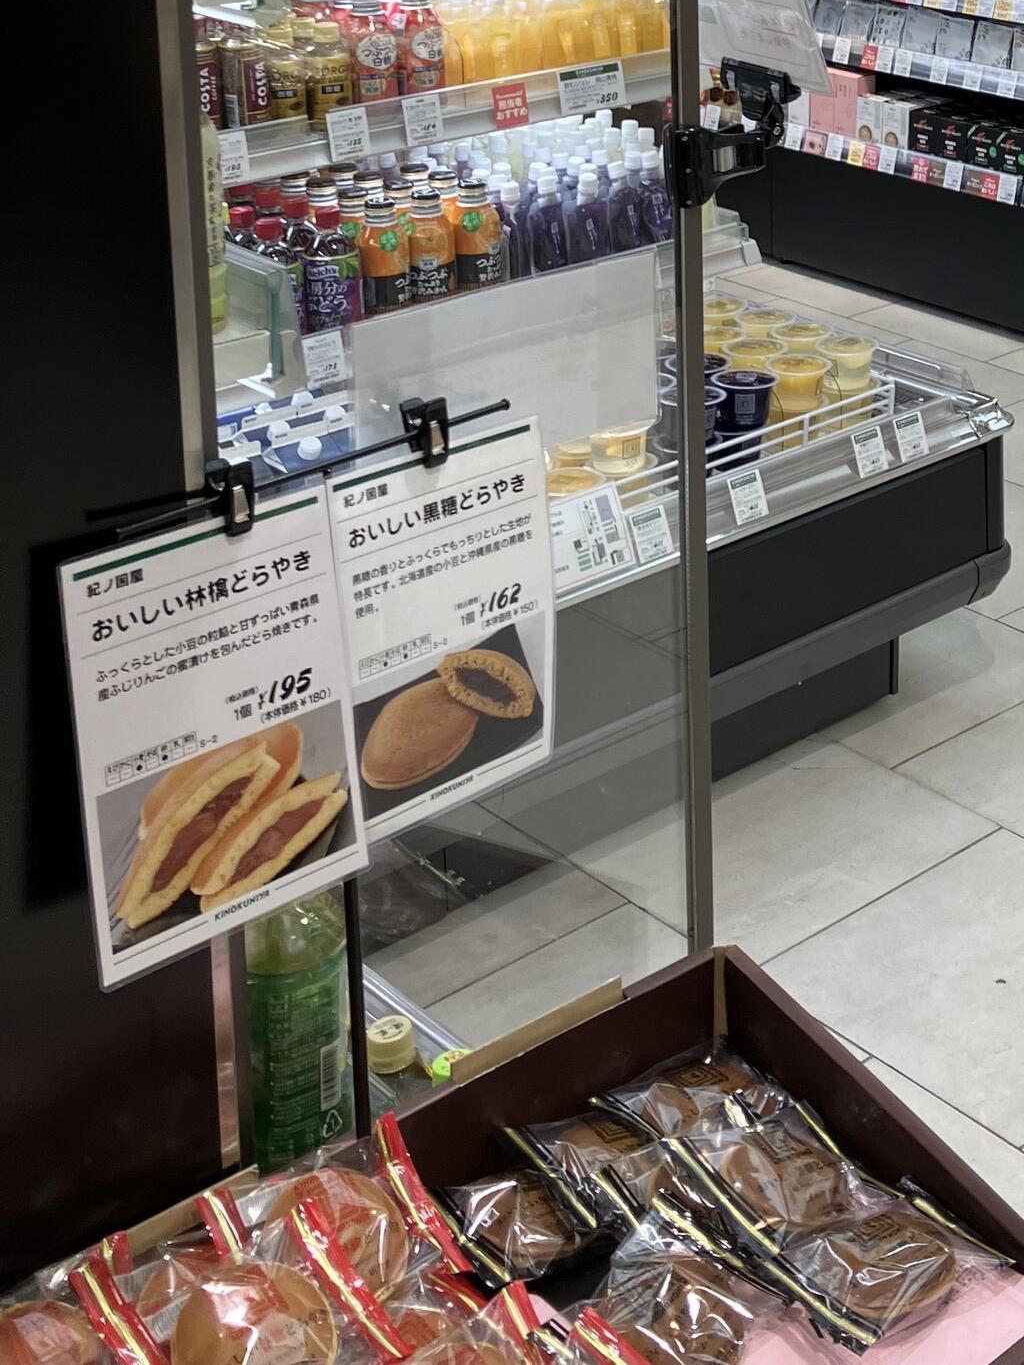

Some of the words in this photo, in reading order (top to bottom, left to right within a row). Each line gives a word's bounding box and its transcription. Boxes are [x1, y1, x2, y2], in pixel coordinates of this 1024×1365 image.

[200, 67, 210, 112] COSTA
[254, 61, 267, 106] COSTA
[496, 108, 528, 120] おすすめ
[342, 484, 389, 509] 紀ノ国屋
[348, 474, 525, 548] おいしい黒糖どらやき
[86, 568, 144, 598] 紀ノ国屋
[91, 550, 312, 643] おいしい林檎どらやき
[480, 583, 522, 618] ¥162
[355, 605, 379, 619] 使用。
[96, 593, 320, 683] ふっくらとした小豆の粒餡と甘ずっぱい青森県
[97, 617, 318, 702] 産ふじりんごの蜜漬けを包んだどら焼きです。
[234, 703, 253, 721] 1個
[256, 667, 313, 710] ¥195
[214, 889, 271, 922] KINOKUNIYA
